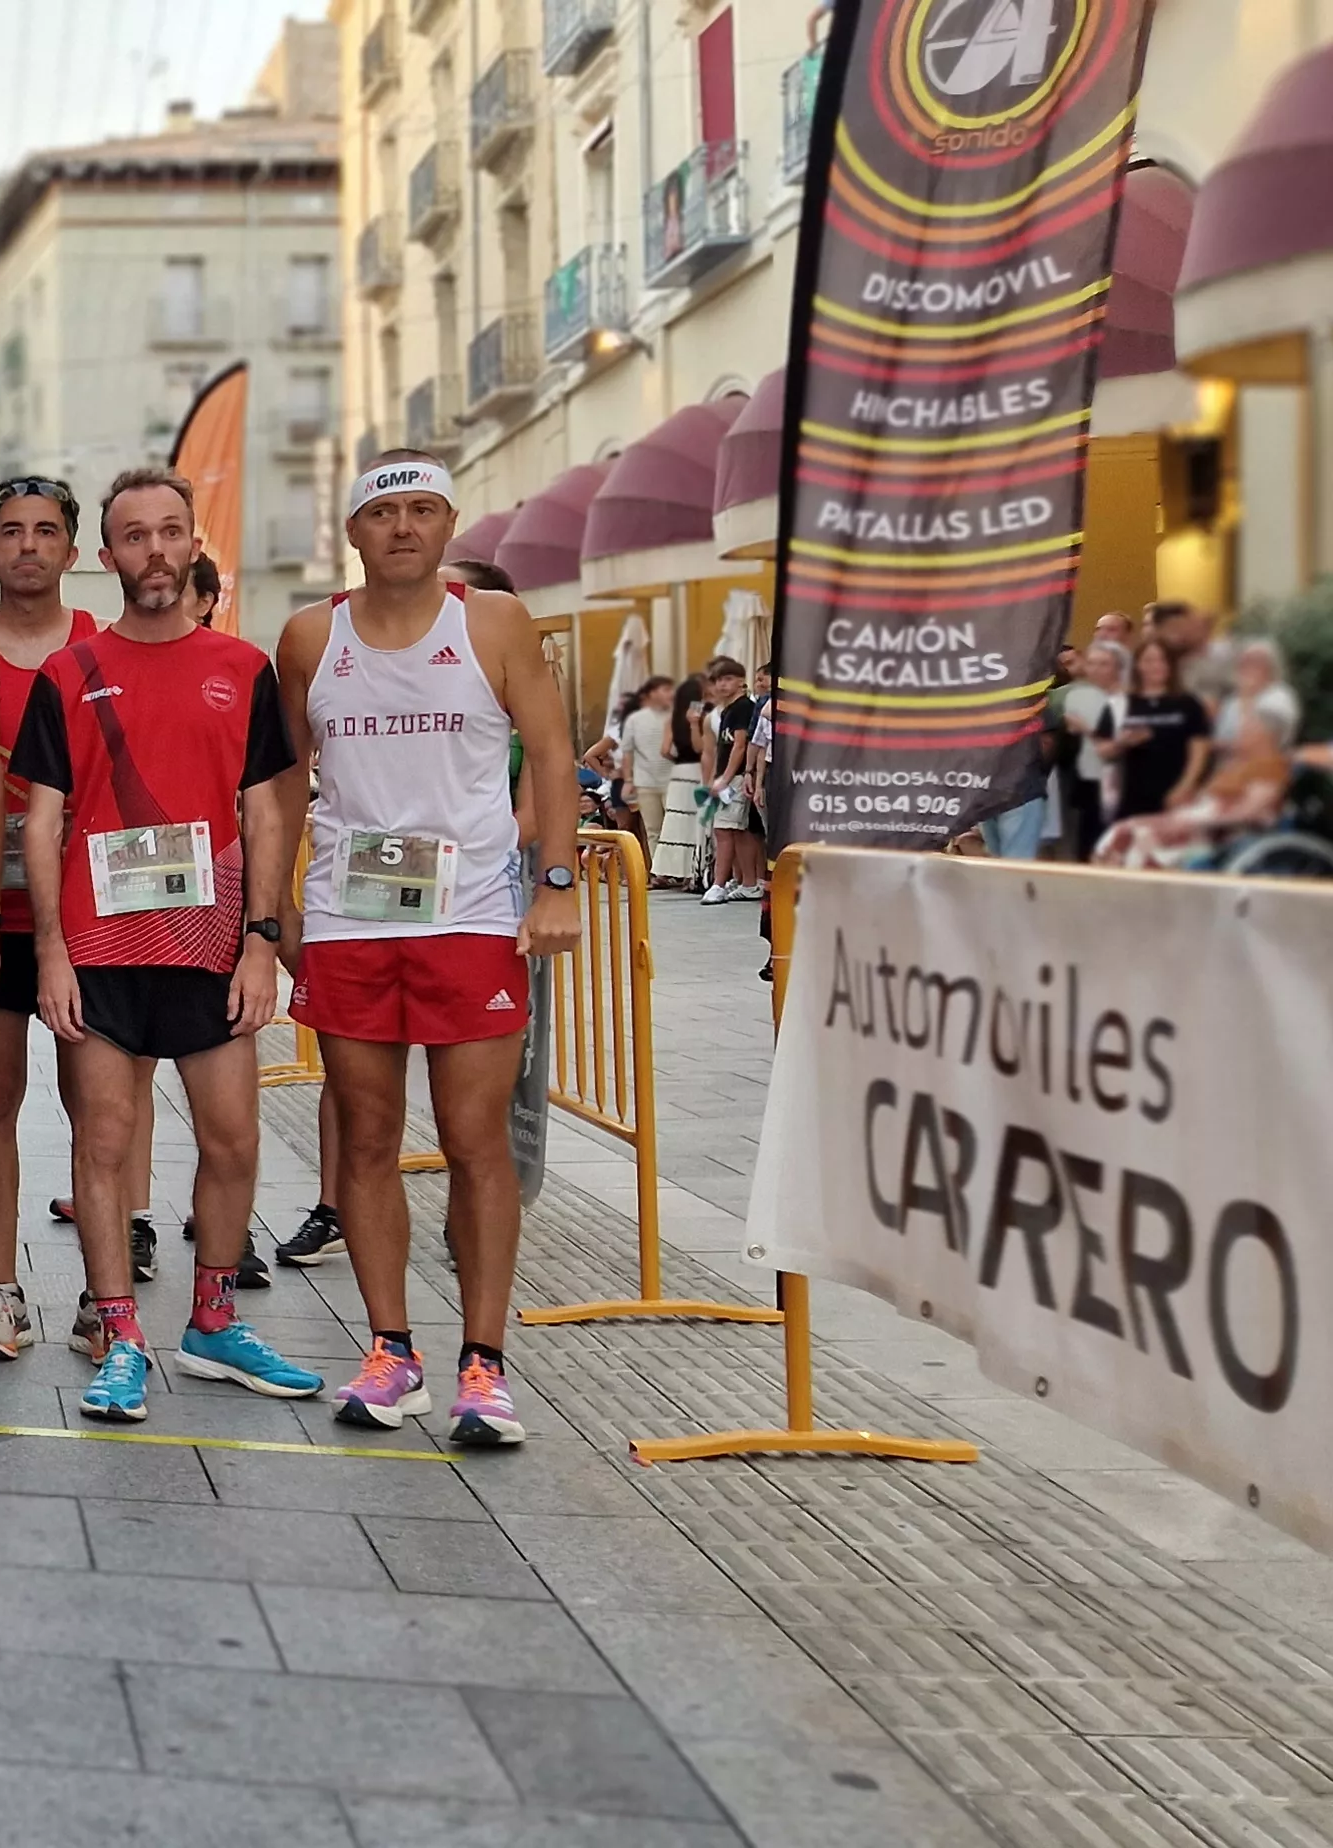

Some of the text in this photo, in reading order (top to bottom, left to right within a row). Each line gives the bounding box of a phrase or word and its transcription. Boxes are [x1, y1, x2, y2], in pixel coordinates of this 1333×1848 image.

[932, 120, 1029, 155] sonido
[376, 470, 420, 490] GMP
[981, 496, 1053, 535] LED
[827, 617, 976, 653] CAMIÓN
[808, 794, 961, 816] 615 064 906
[138, 829, 157, 856] 1
[380, 837, 404, 866] 5
[864, 1076, 1300, 1414] CARRERO
